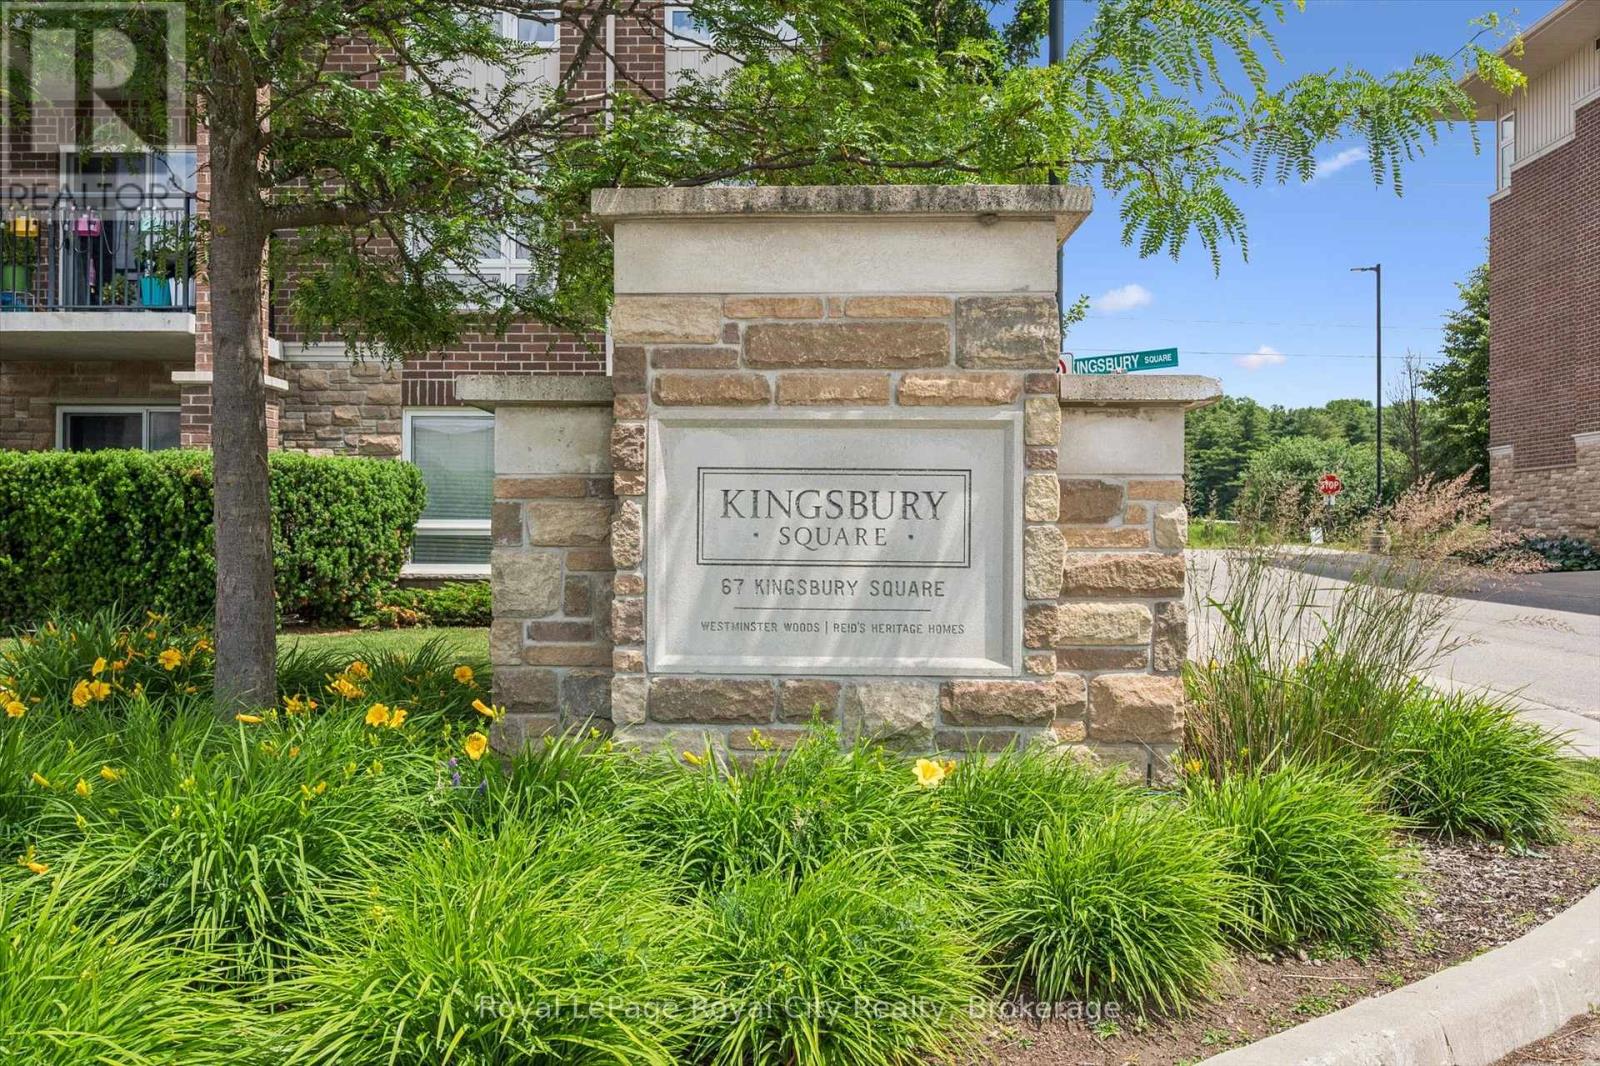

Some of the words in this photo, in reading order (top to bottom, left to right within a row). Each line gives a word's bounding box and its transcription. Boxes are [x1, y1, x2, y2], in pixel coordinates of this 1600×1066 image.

[1144, 354, 1172, 364] SQUARE
[1320, 480, 1339, 490] STOP
[720, 489, 948, 520] KINGSBURY
[778, 526, 888, 551] SQUARE
[721, 579, 744, 595] 67
[755, 579, 858, 597] KINGSBURY
[870, 581, 945, 597] SQUARE
[701, 621, 778, 633] WESTMINSTER
[783, 622, 820, 633] WOODS
[833, 621, 866, 634] REID'S
[871, 624, 923, 635] HERITAGE
[928, 625, 965, 635] HOMES
